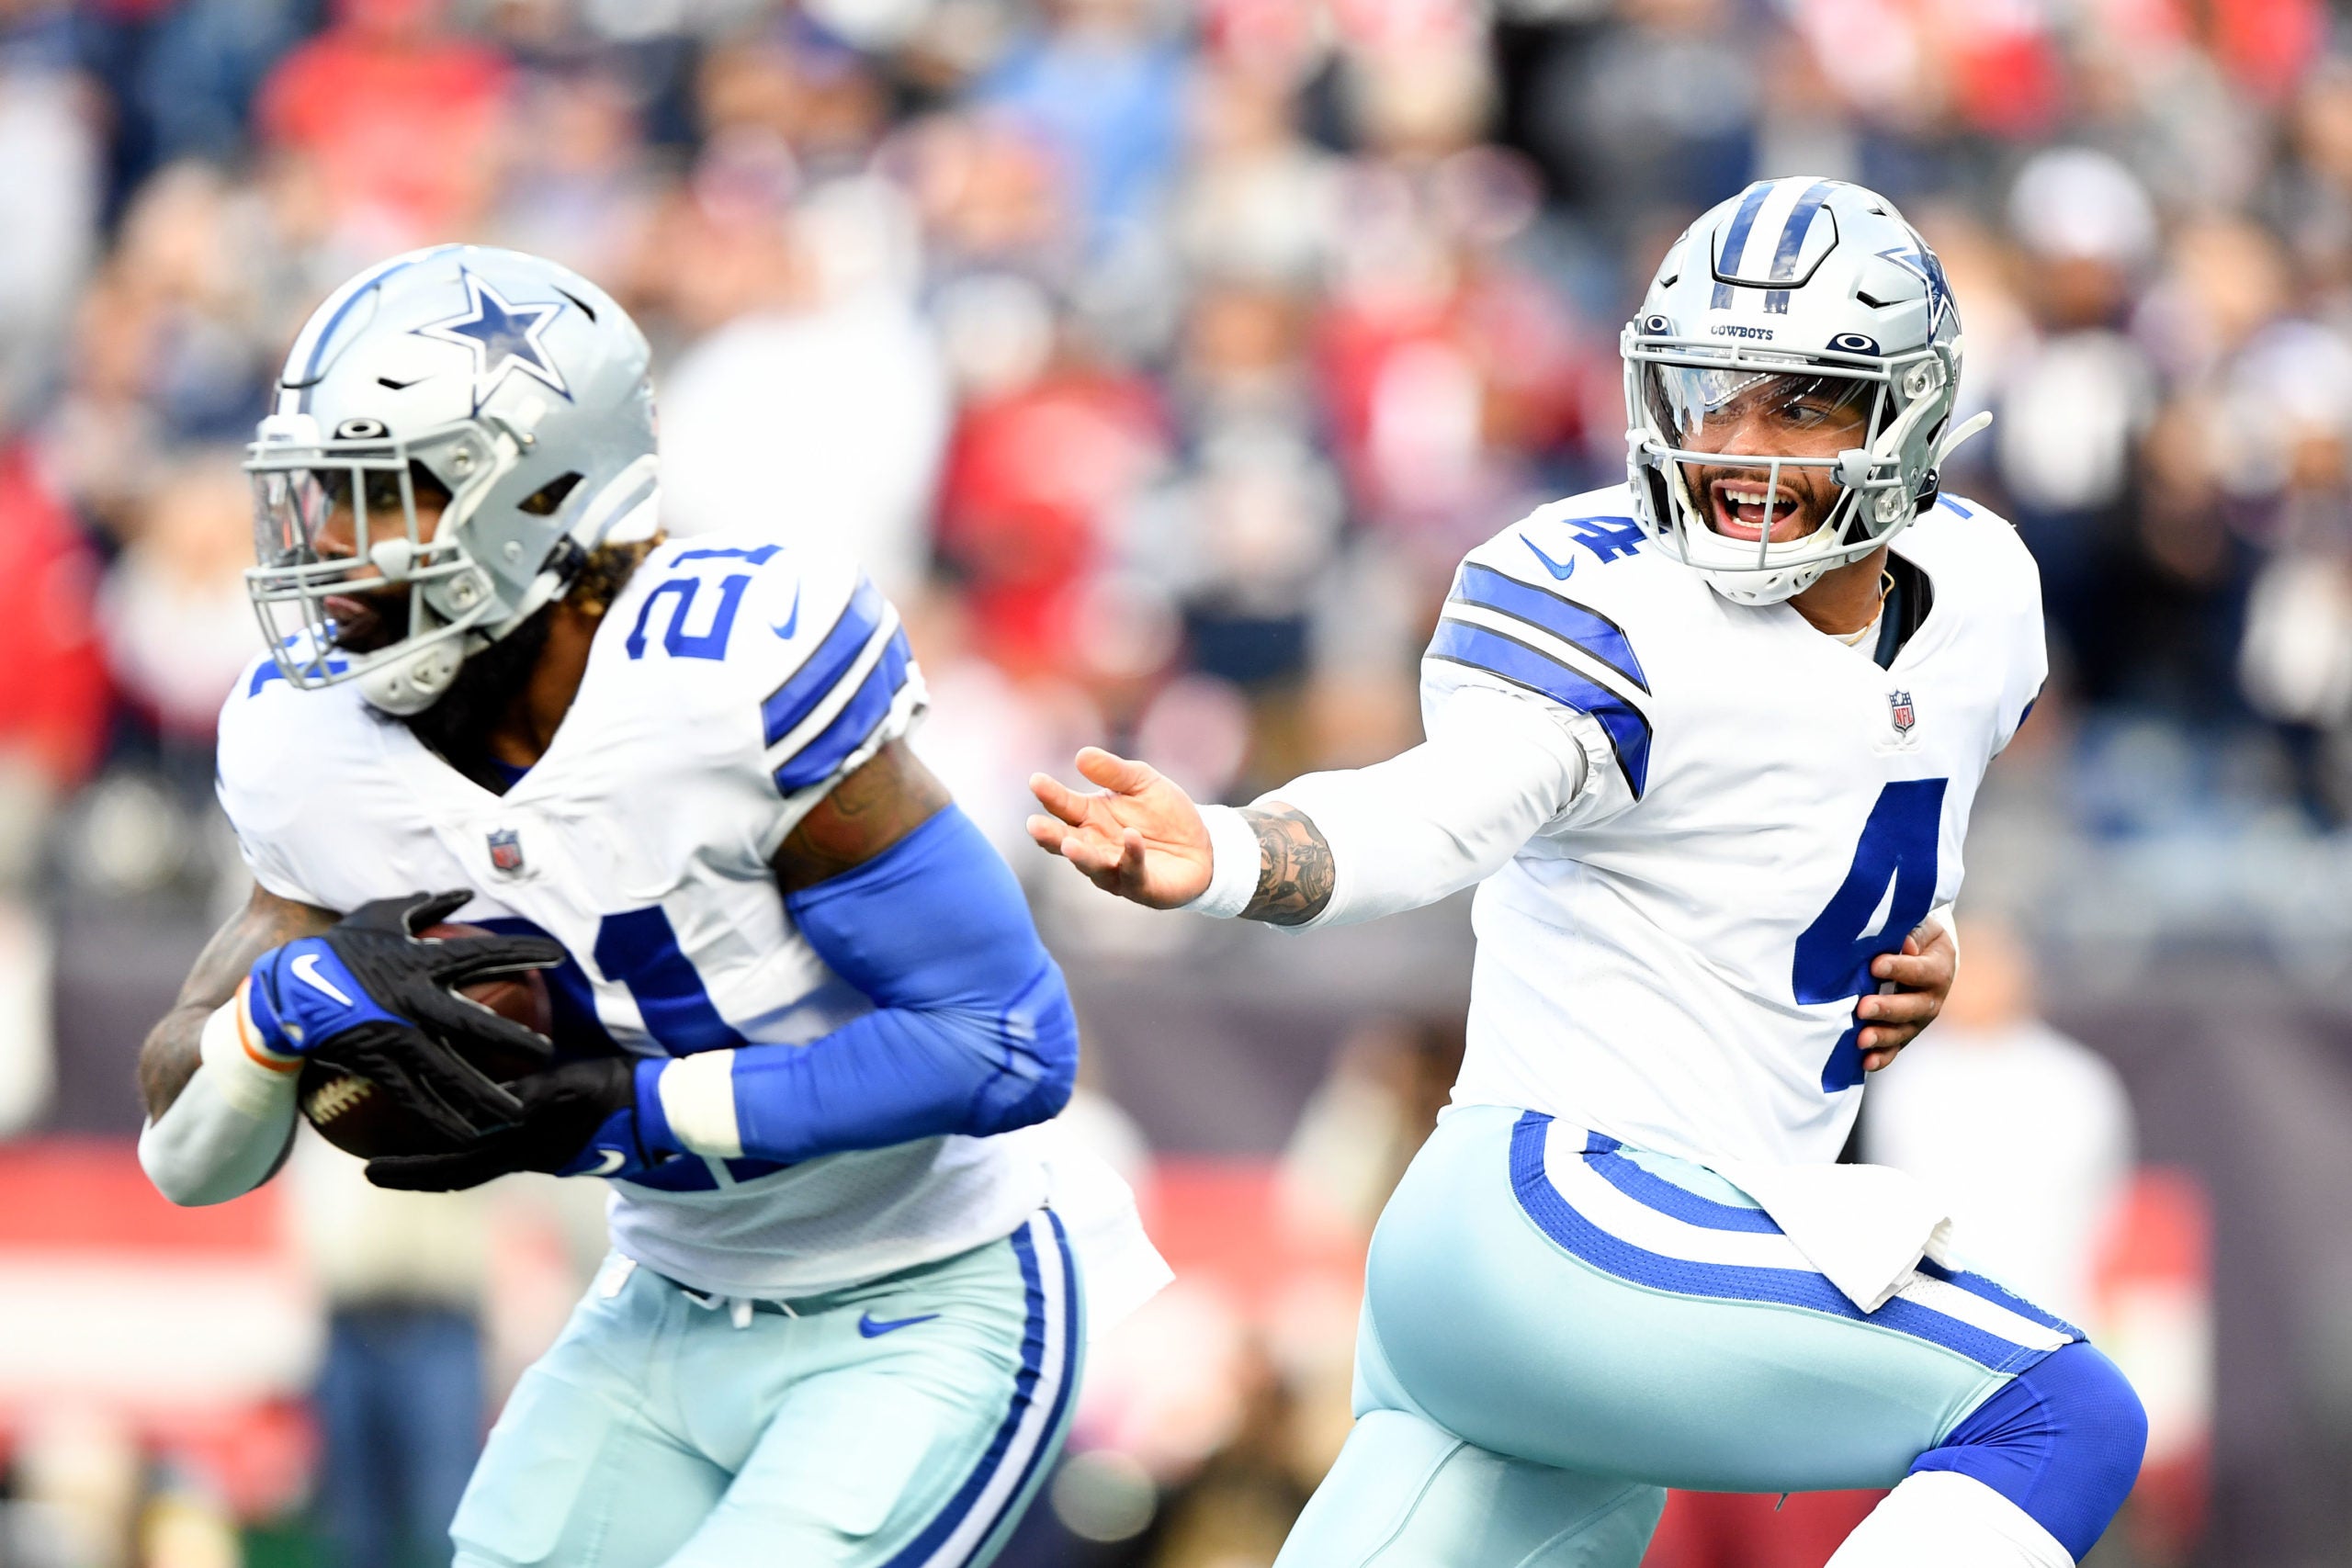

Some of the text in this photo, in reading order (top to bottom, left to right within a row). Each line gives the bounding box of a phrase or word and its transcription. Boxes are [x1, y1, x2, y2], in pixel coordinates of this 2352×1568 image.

[1711, 325, 1773, 341] COWBOYS
[1562, 516, 1659, 564] 4
[623, 544, 784, 661] 21
[1894, 707, 1914, 727] NFL
[1792, 777, 1950, 1093] 4
